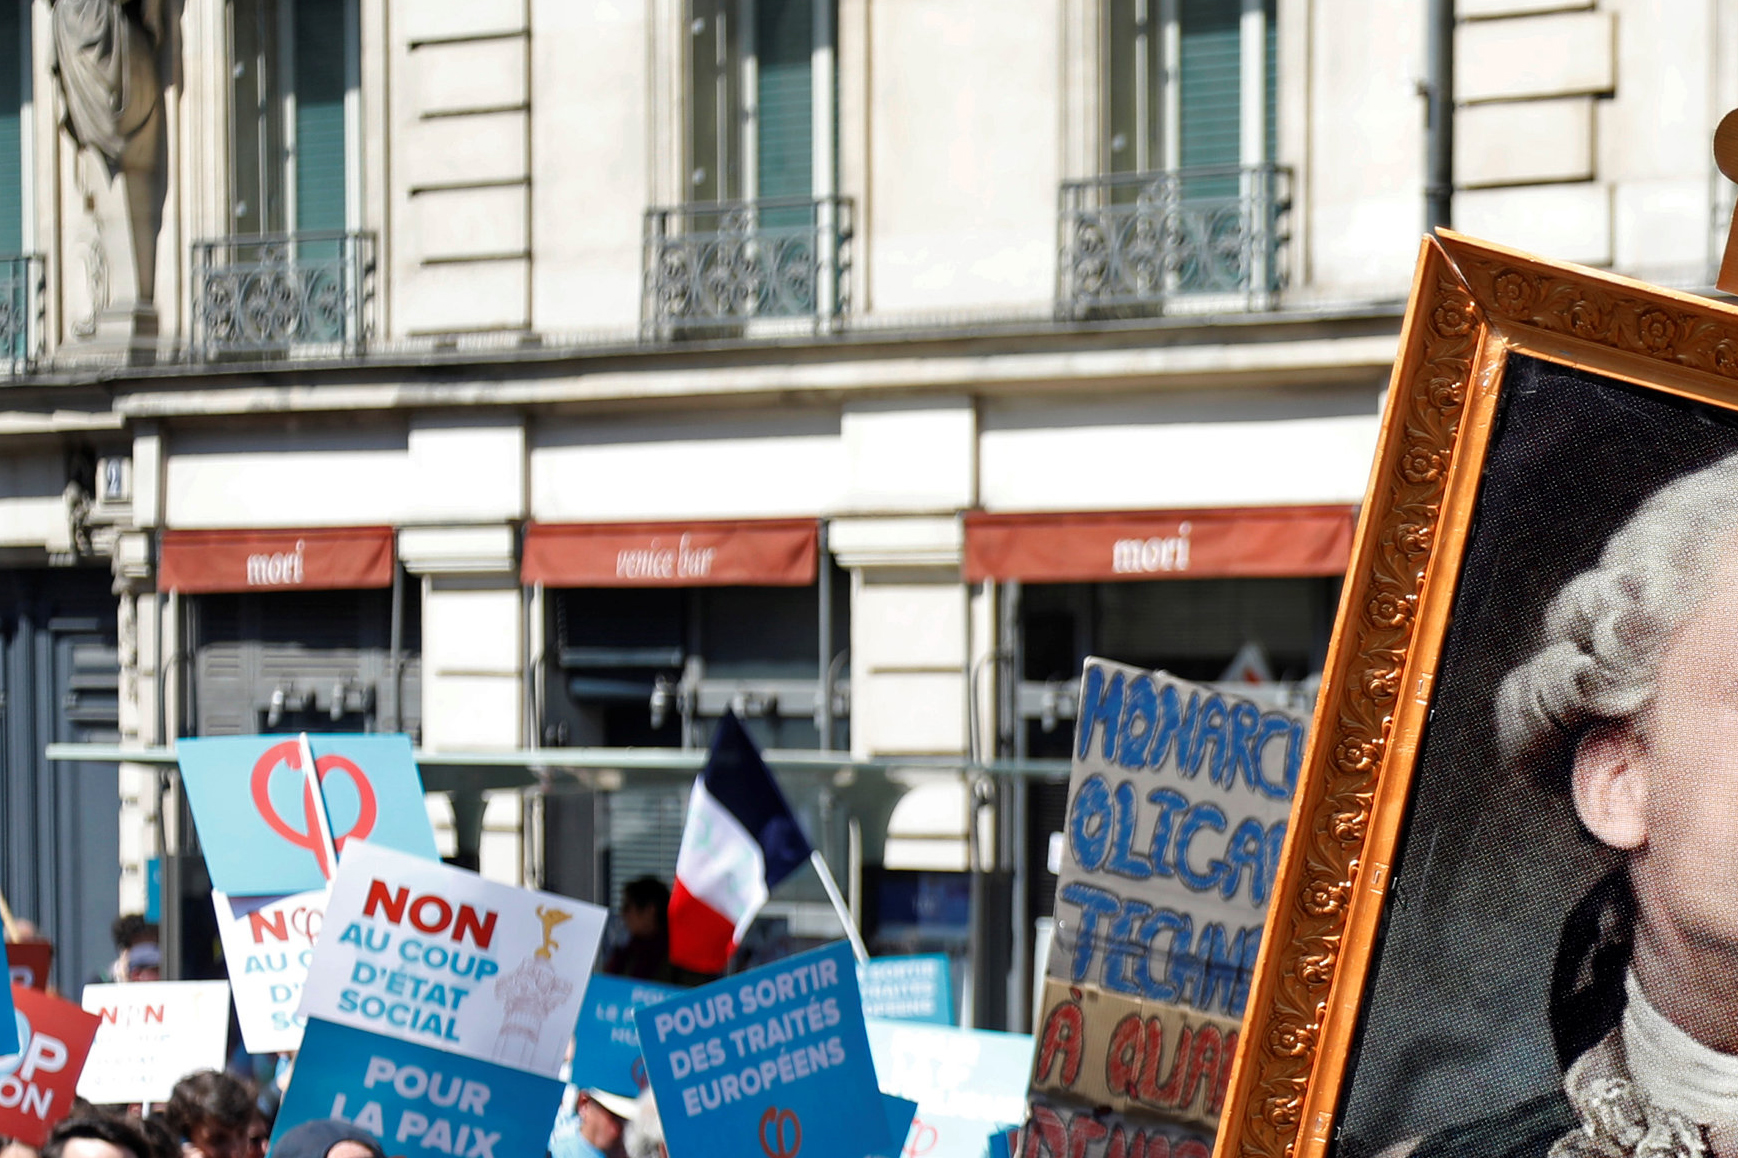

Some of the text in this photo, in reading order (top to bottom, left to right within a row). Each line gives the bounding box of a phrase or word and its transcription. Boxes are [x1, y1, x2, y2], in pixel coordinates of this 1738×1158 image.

[247, 538, 305, 585] mori
[1112, 520, 1192, 573] mori
[362, 879, 499, 950] NON
[245, 952, 288, 974] AU
[338, 922, 499, 983] AU COUP
[338, 988, 460, 1044] SOCIAL
[654, 958, 839, 1043] POUR SORTIR
[669, 997, 841, 1080] DES TRAITÉS
[364, 1056, 491, 1116] POUR
[682, 1036, 846, 1117] EUROPÉENS
[330, 1092, 384, 1138] LA
